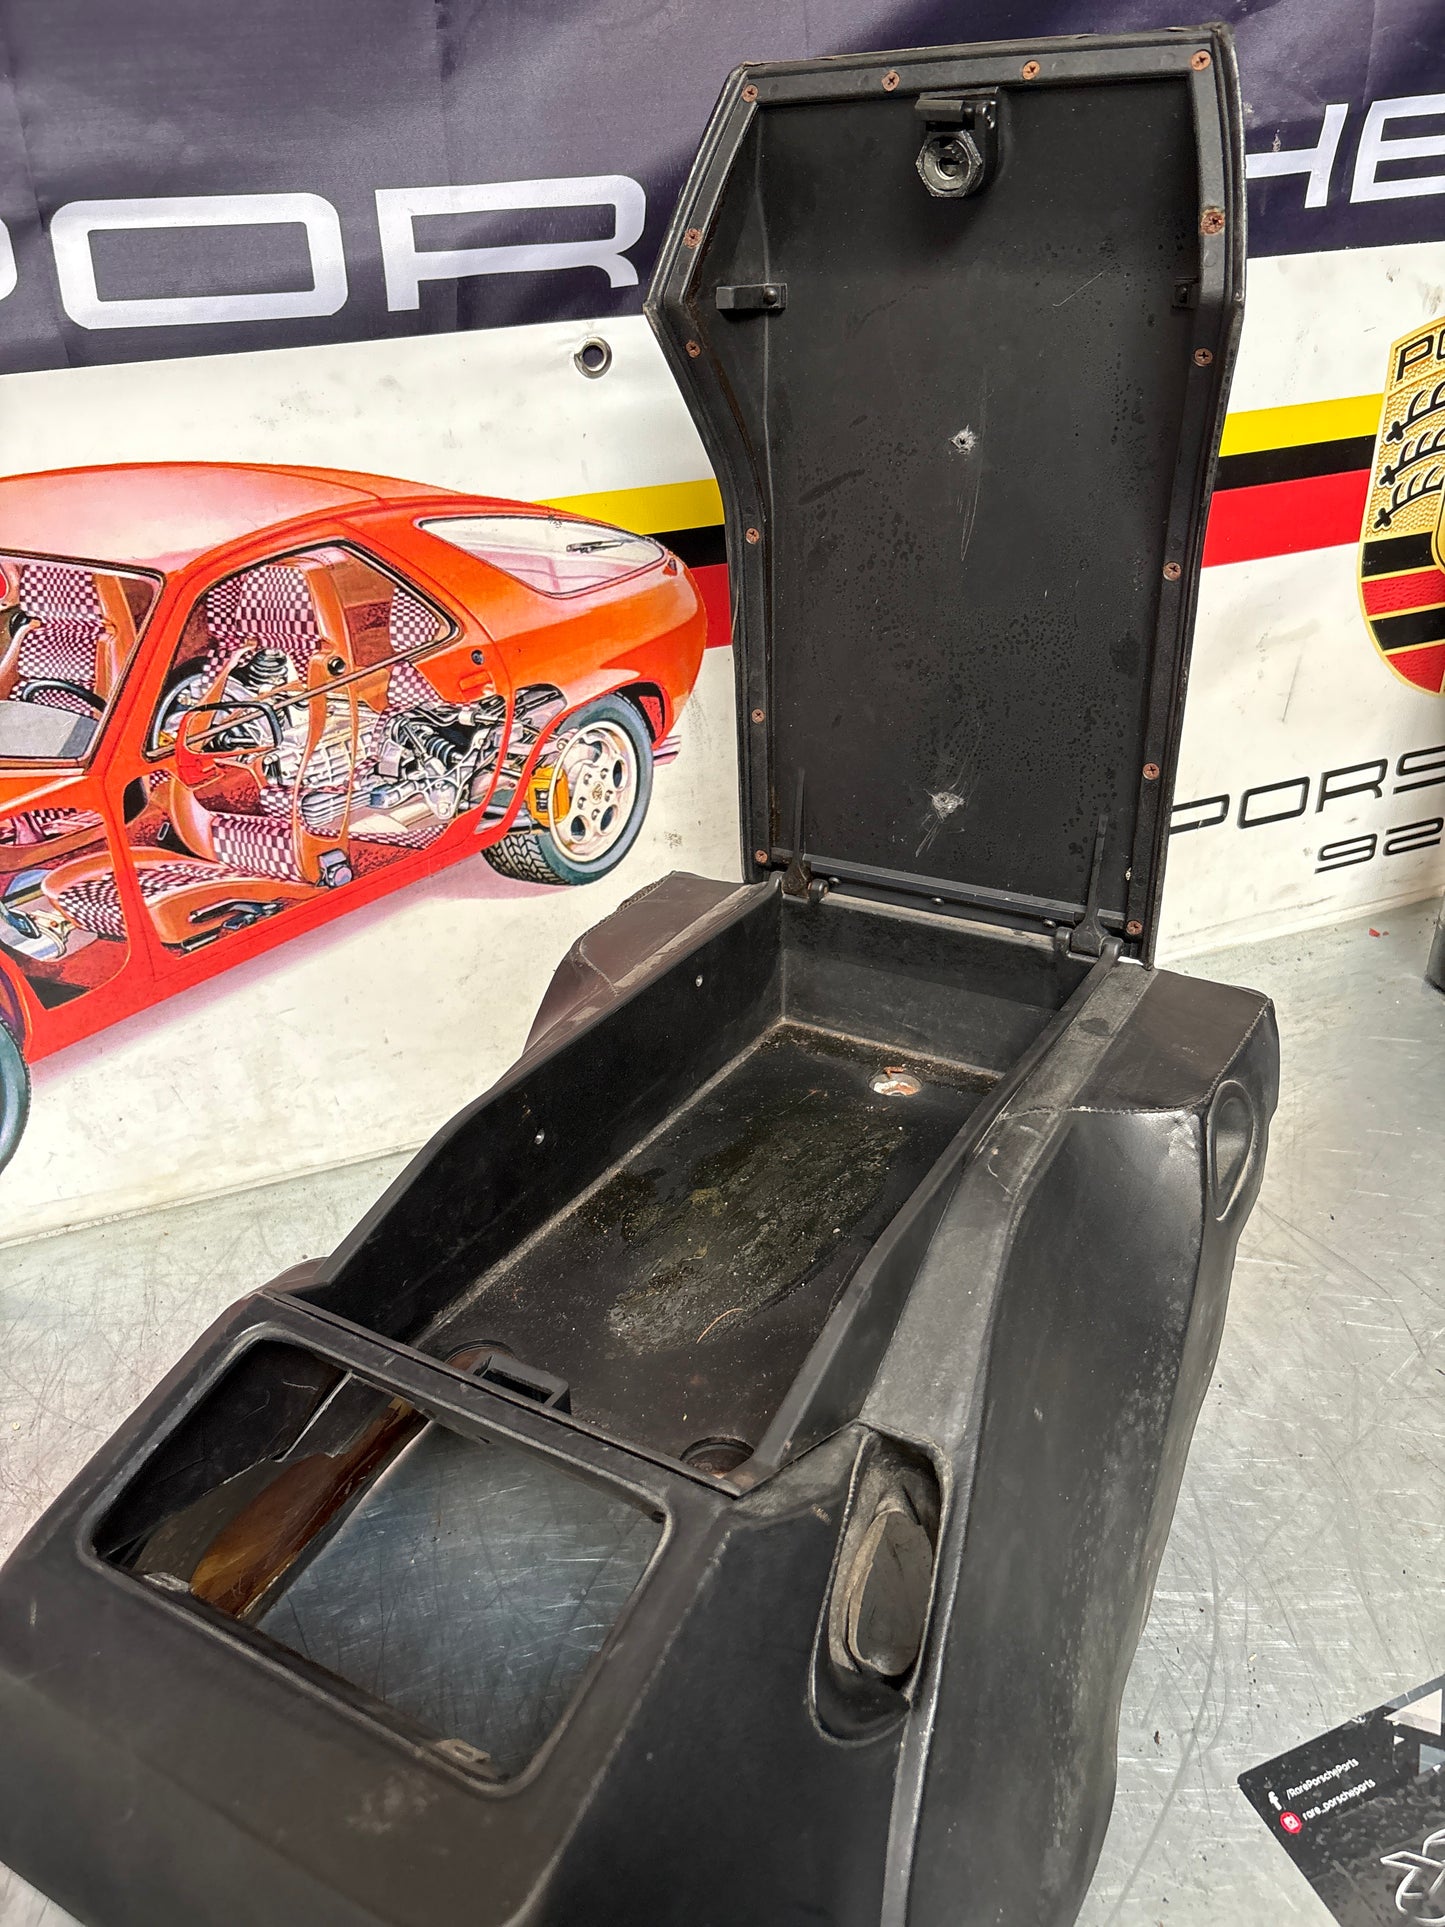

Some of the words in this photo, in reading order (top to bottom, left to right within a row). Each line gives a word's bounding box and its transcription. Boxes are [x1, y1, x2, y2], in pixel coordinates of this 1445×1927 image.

[0, 174, 646, 330] OR
[1396, 328, 1445, 382] P
[1169, 745, 1445, 835] PORS
[1313, 817, 1444, 874] 92
[1302, 1778, 1376, 1821] rare_porscheparts
